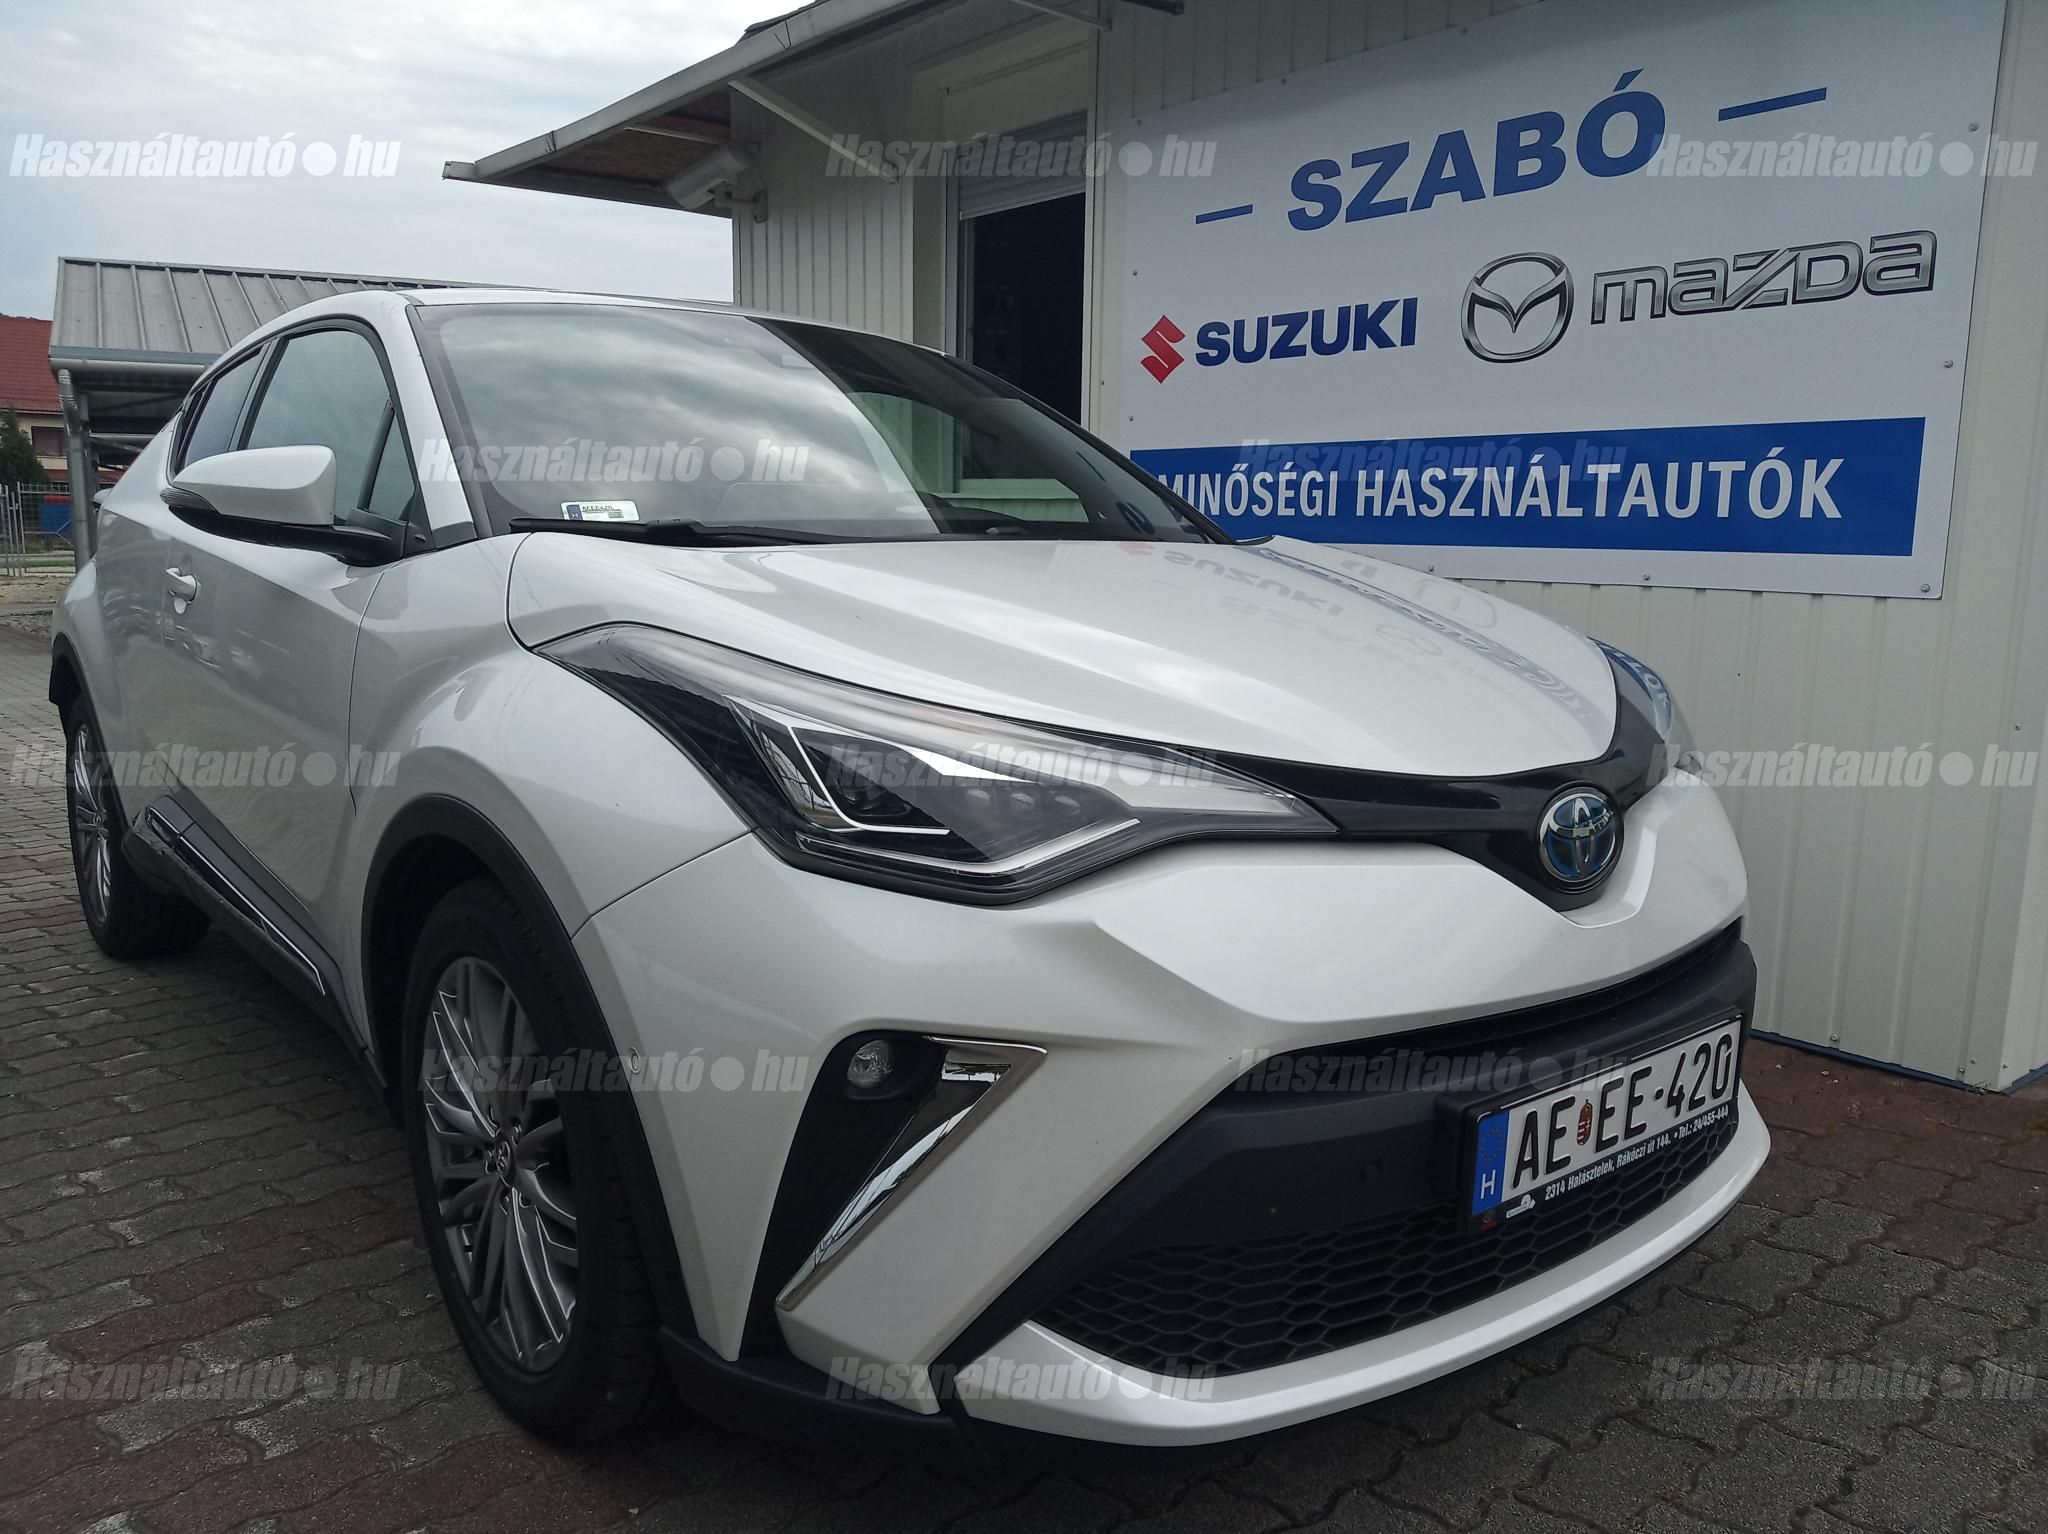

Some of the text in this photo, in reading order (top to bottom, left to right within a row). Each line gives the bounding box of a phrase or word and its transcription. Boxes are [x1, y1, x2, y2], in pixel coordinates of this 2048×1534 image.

[1287, 69, 1666, 231] SZABÓ
[1196, 297, 1418, 367] SUZUKI
[1356, 447, 1845, 519] HASZNÁLTAUTÓK
[1511, 1033, 1733, 1189] AE EE-420
[1480, 1169, 1496, 1199] H
[1545, 1181, 1566, 1200] 2314
